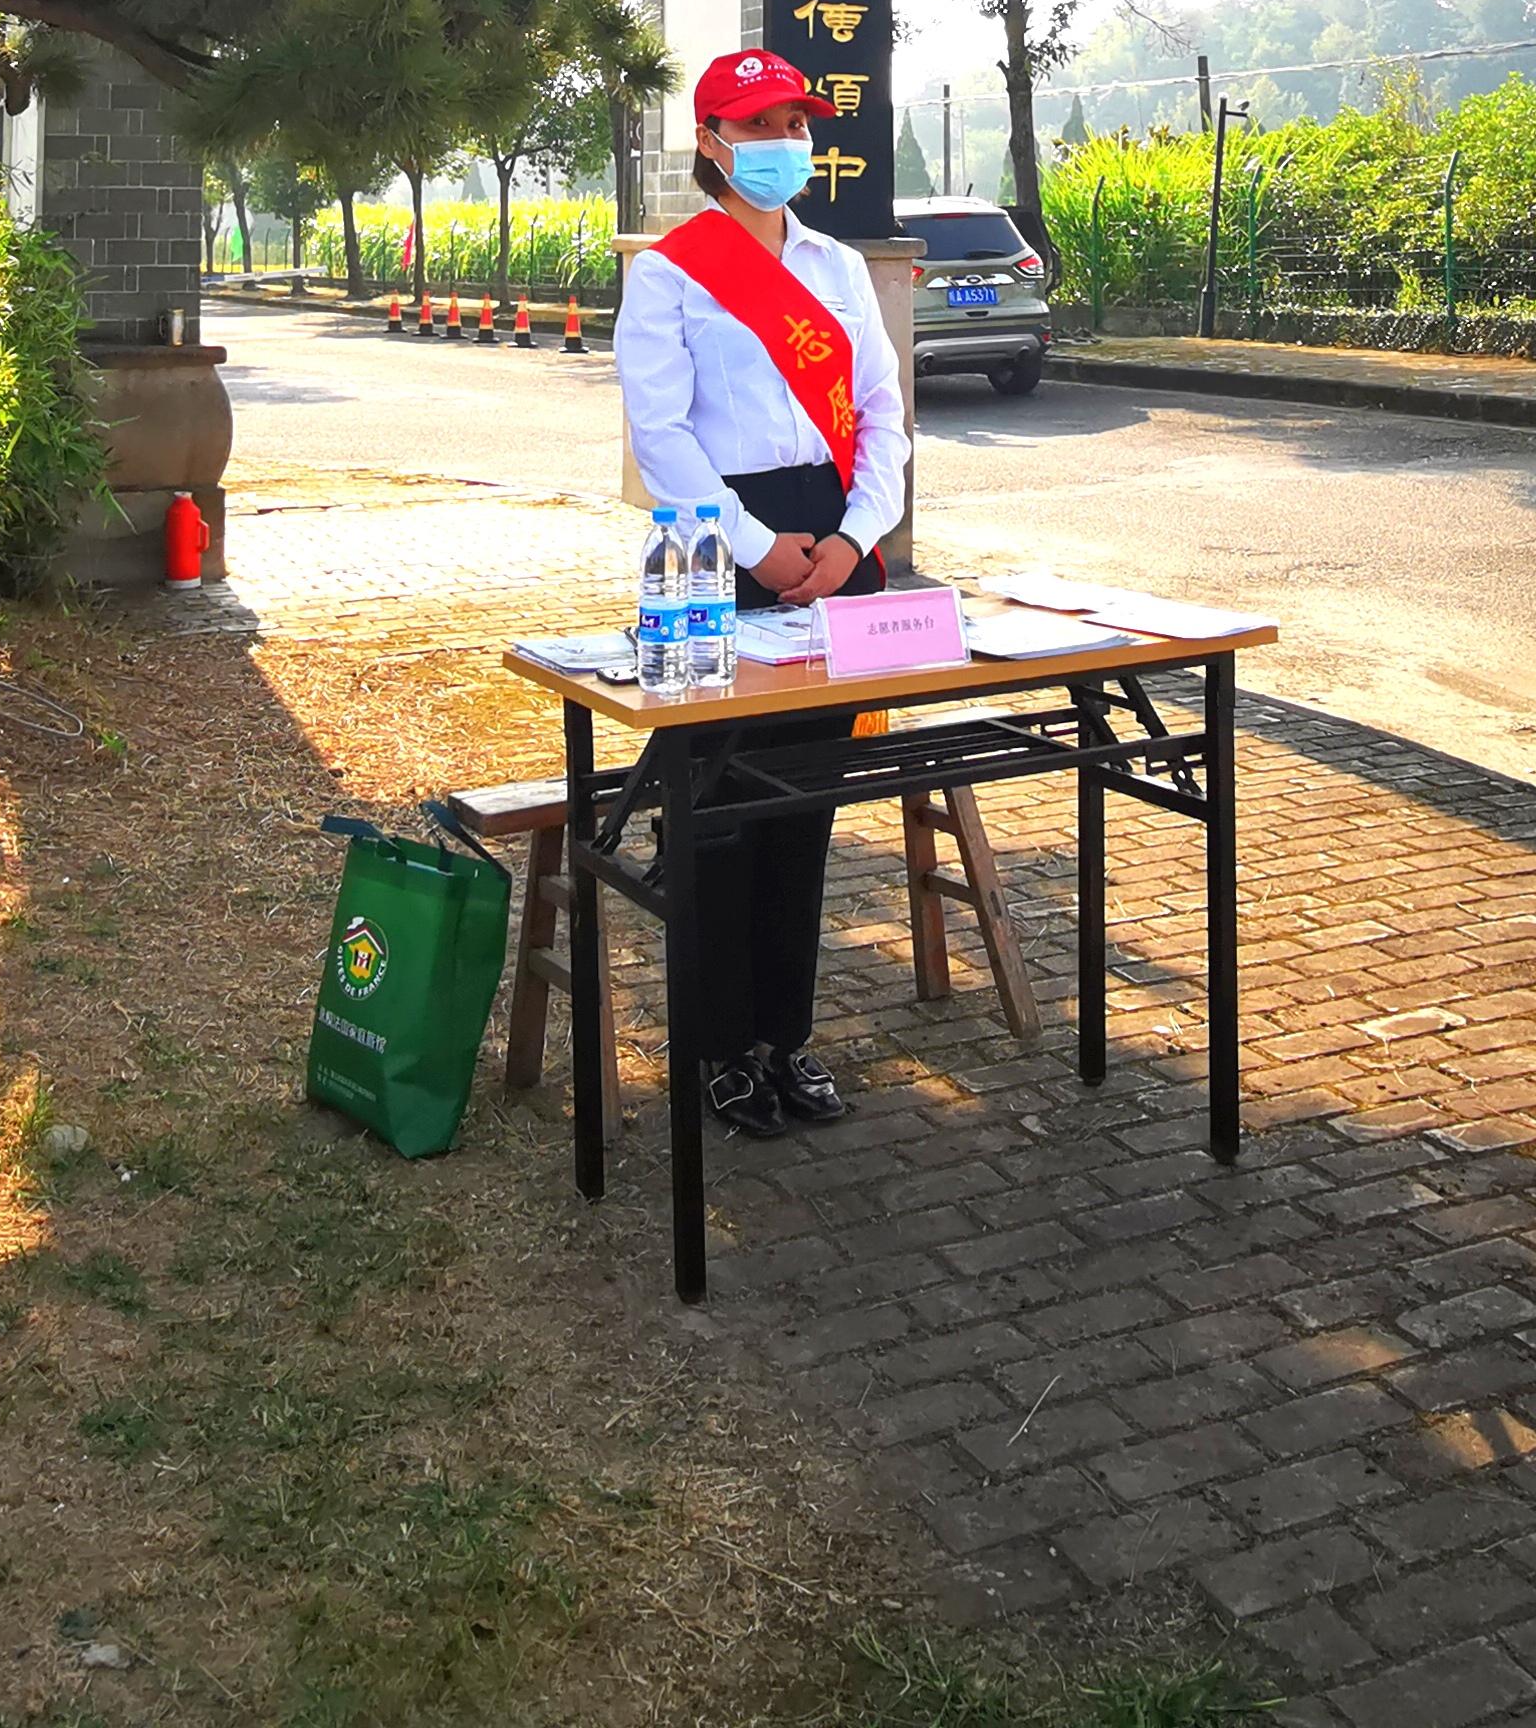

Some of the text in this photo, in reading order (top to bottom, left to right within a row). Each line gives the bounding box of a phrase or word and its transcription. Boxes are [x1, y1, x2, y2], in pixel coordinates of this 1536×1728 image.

[867, 615, 934, 636] 志愿者服务台
[357, 959, 387, 998] FRANCE
